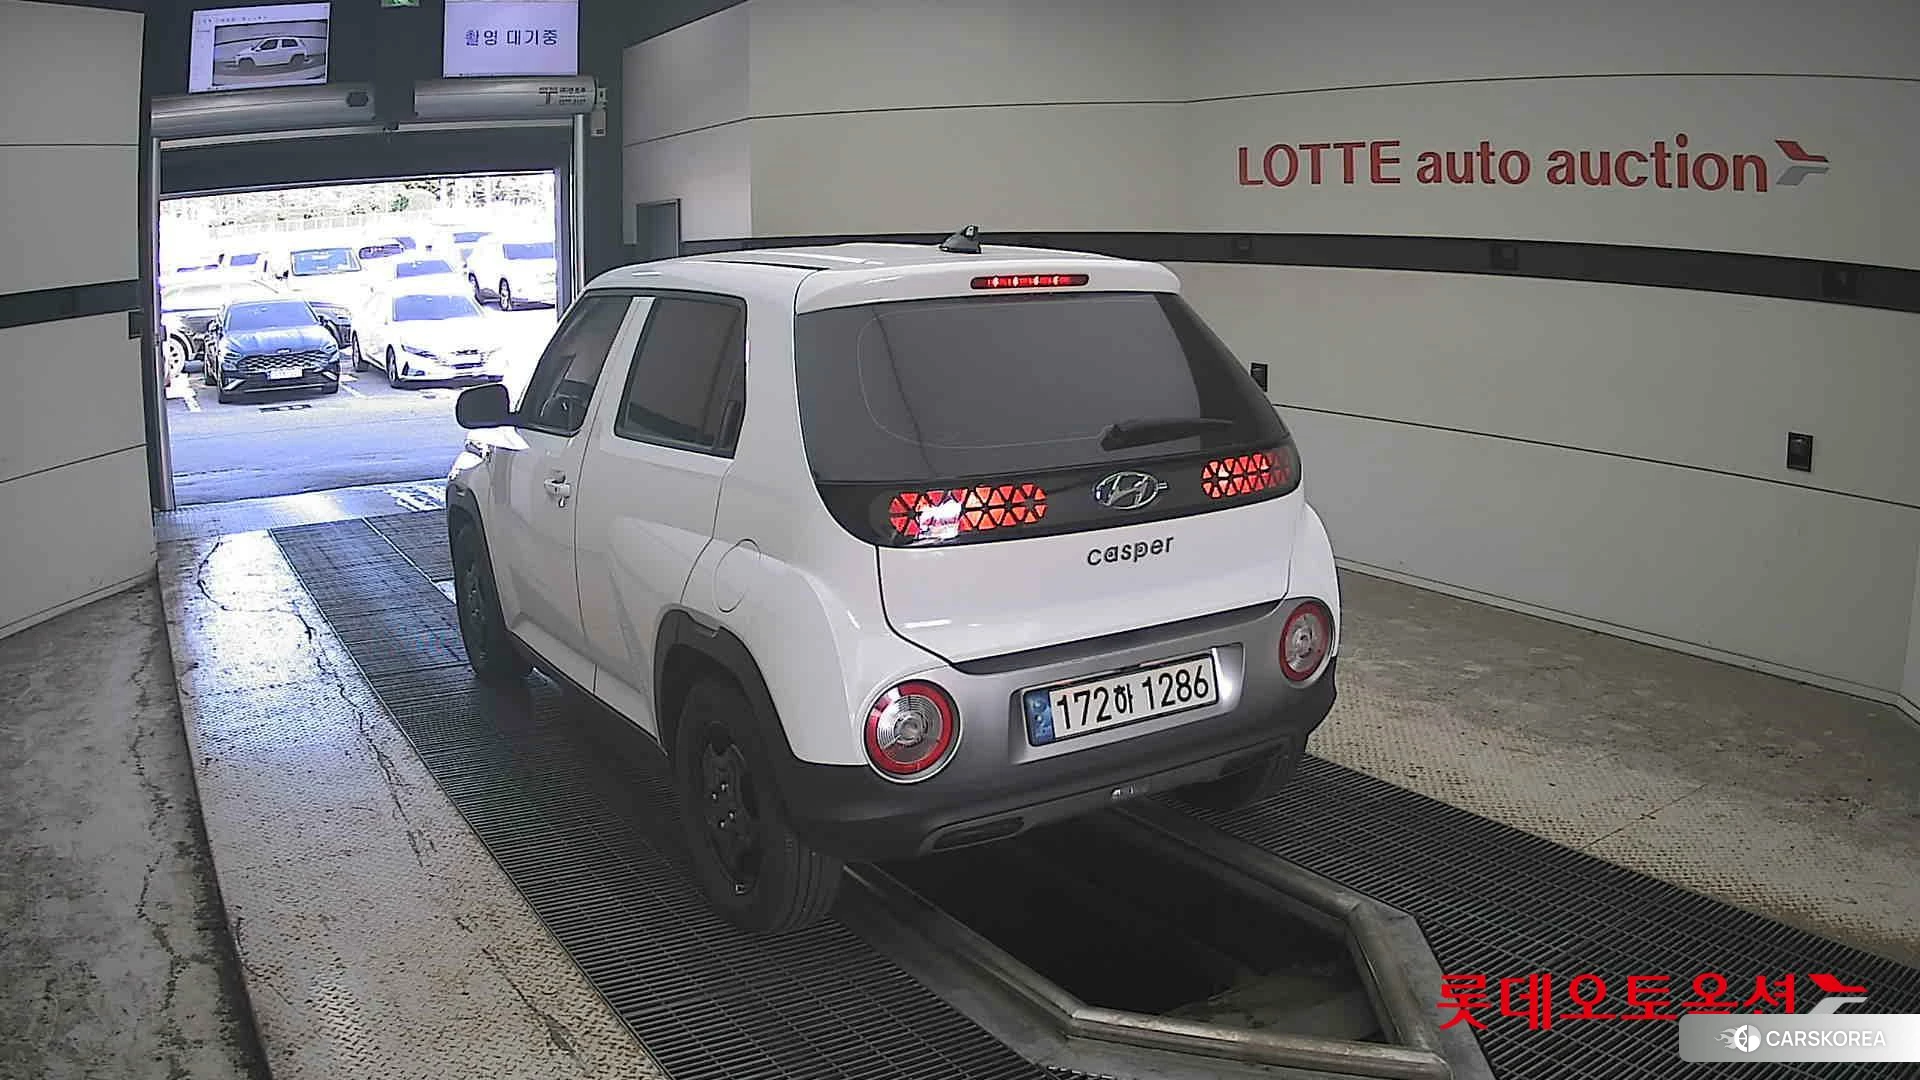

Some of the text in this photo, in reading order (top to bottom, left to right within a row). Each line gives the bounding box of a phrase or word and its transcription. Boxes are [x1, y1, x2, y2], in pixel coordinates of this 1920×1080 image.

[507, 29, 558, 46] 대기중
[1238, 133, 1768, 192] LOTTE auto auction
[1087, 536, 1174, 566] casper
[1056, 664, 1209, 730] 172하 1286
